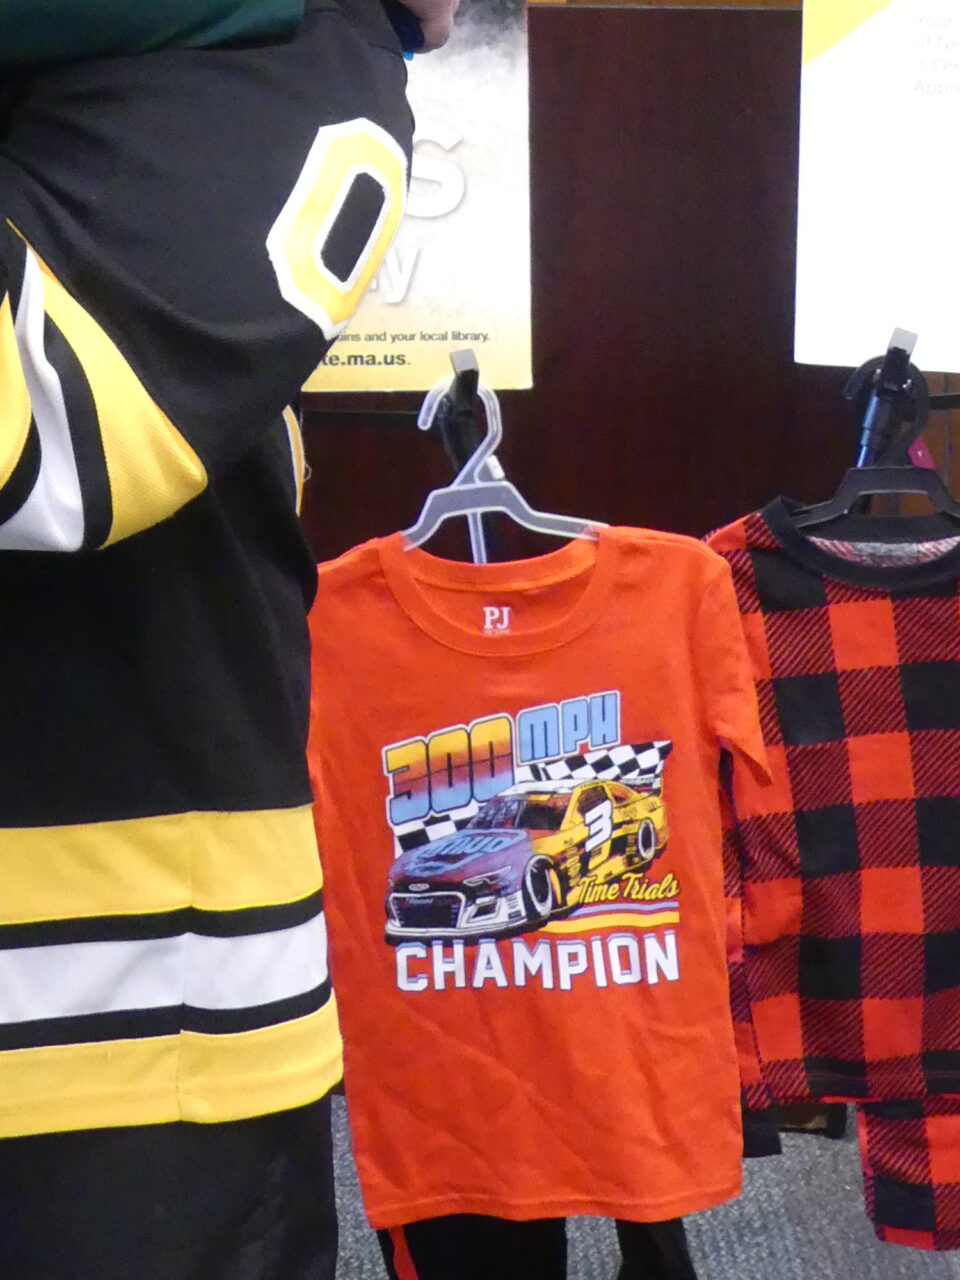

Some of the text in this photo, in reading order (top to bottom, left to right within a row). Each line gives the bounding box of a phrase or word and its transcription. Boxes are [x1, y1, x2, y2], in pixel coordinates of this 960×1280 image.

[364, 330, 387, 342] and
[390, 332, 416, 344] your
[419, 330, 448, 342] local
[451, 330, 491, 344] library.
[482, 605, 512, 629] PJ
[382, 690, 621, 826] 300 MPH
[584, 799, 614, 854] 3
[578, 872, 681, 905] Time Trials
[395, 930, 680, 992] CHAMPION
